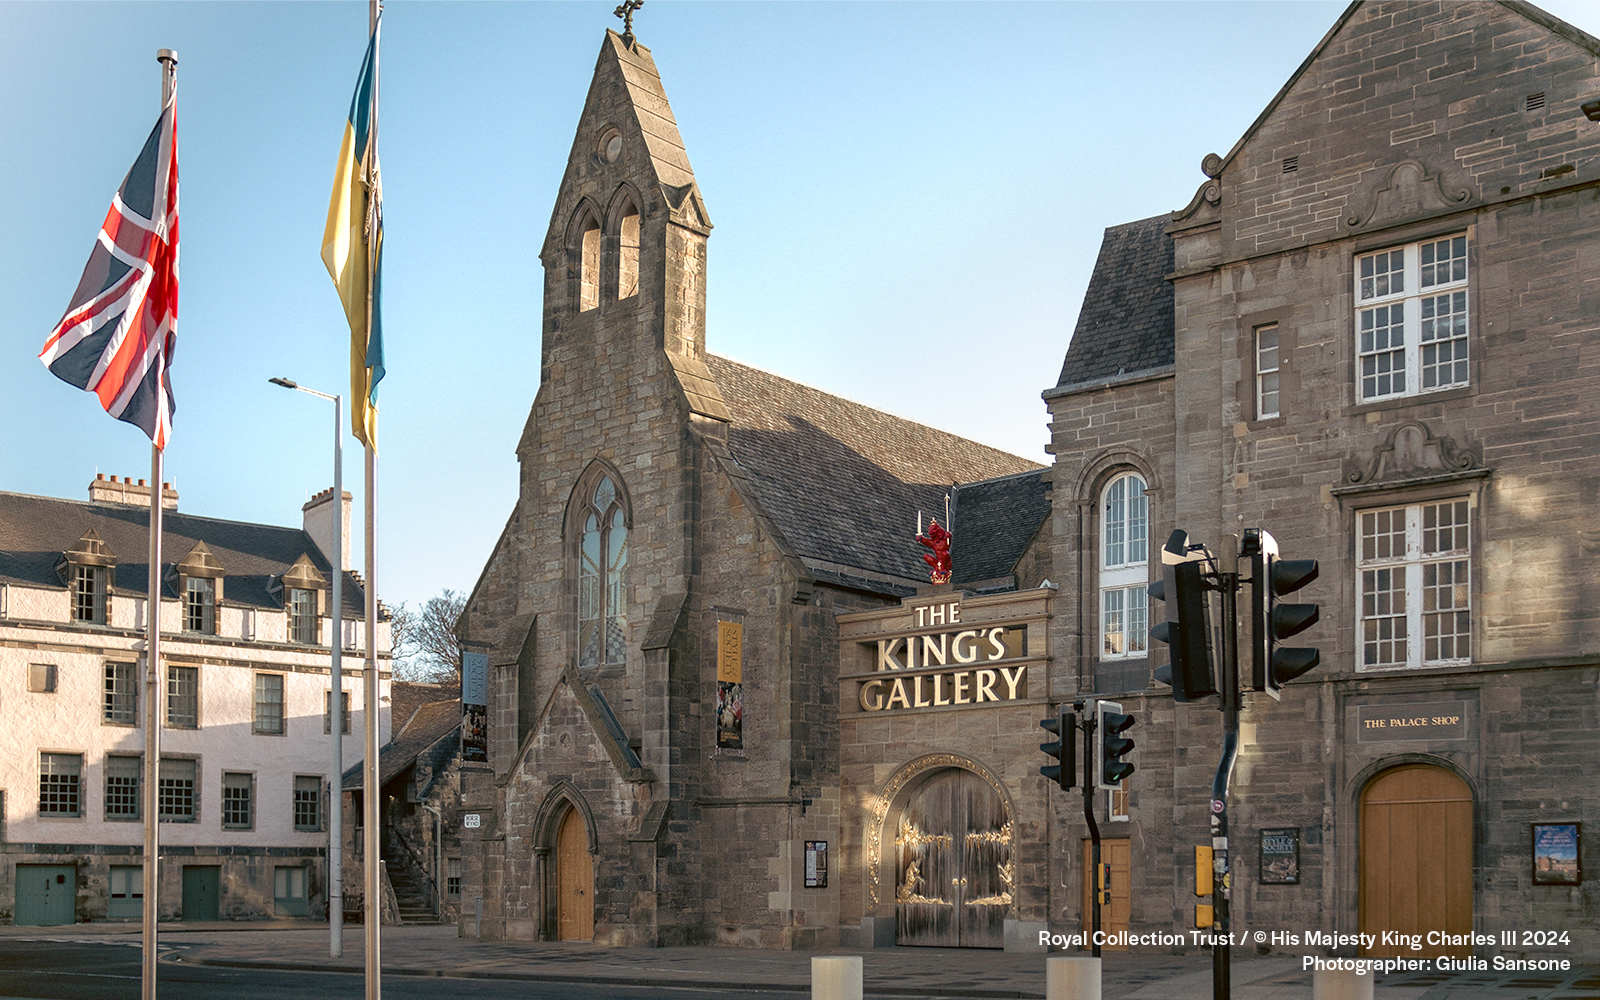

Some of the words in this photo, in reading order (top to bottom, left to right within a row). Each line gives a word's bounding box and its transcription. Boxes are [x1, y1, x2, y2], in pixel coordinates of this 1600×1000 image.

[915, 602, 960, 627] THE
[877, 626, 1005, 671] KING'S
[859, 666, 1027, 711] GALLERY
[1364, 719, 1386, 729] THE
[1390, 717, 1428, 727] PALACE
[1431, 716, 1460, 726] SHOP
